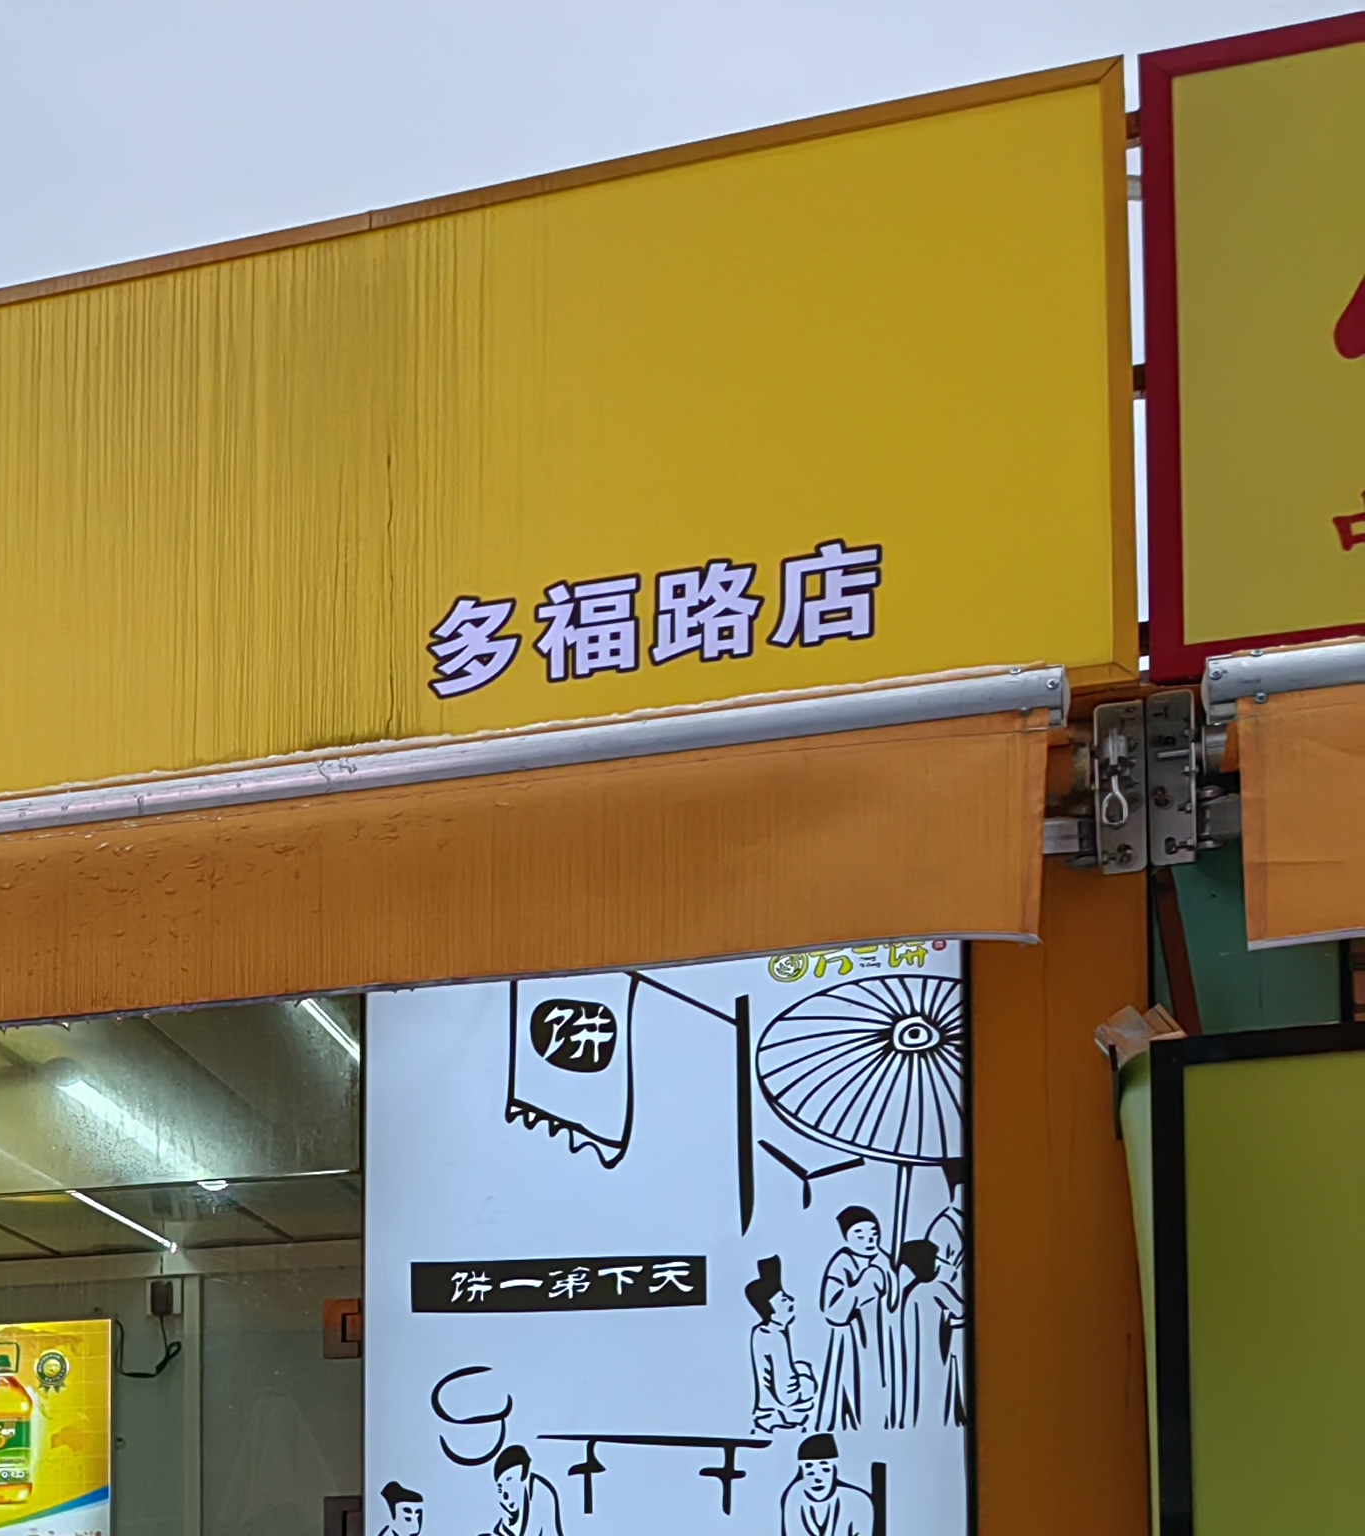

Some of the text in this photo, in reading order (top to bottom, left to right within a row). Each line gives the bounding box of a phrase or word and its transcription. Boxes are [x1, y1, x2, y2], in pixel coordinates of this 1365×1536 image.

[429, 540, 883, 699] 多福路店
[542, 1006, 615, 1063] 饼
